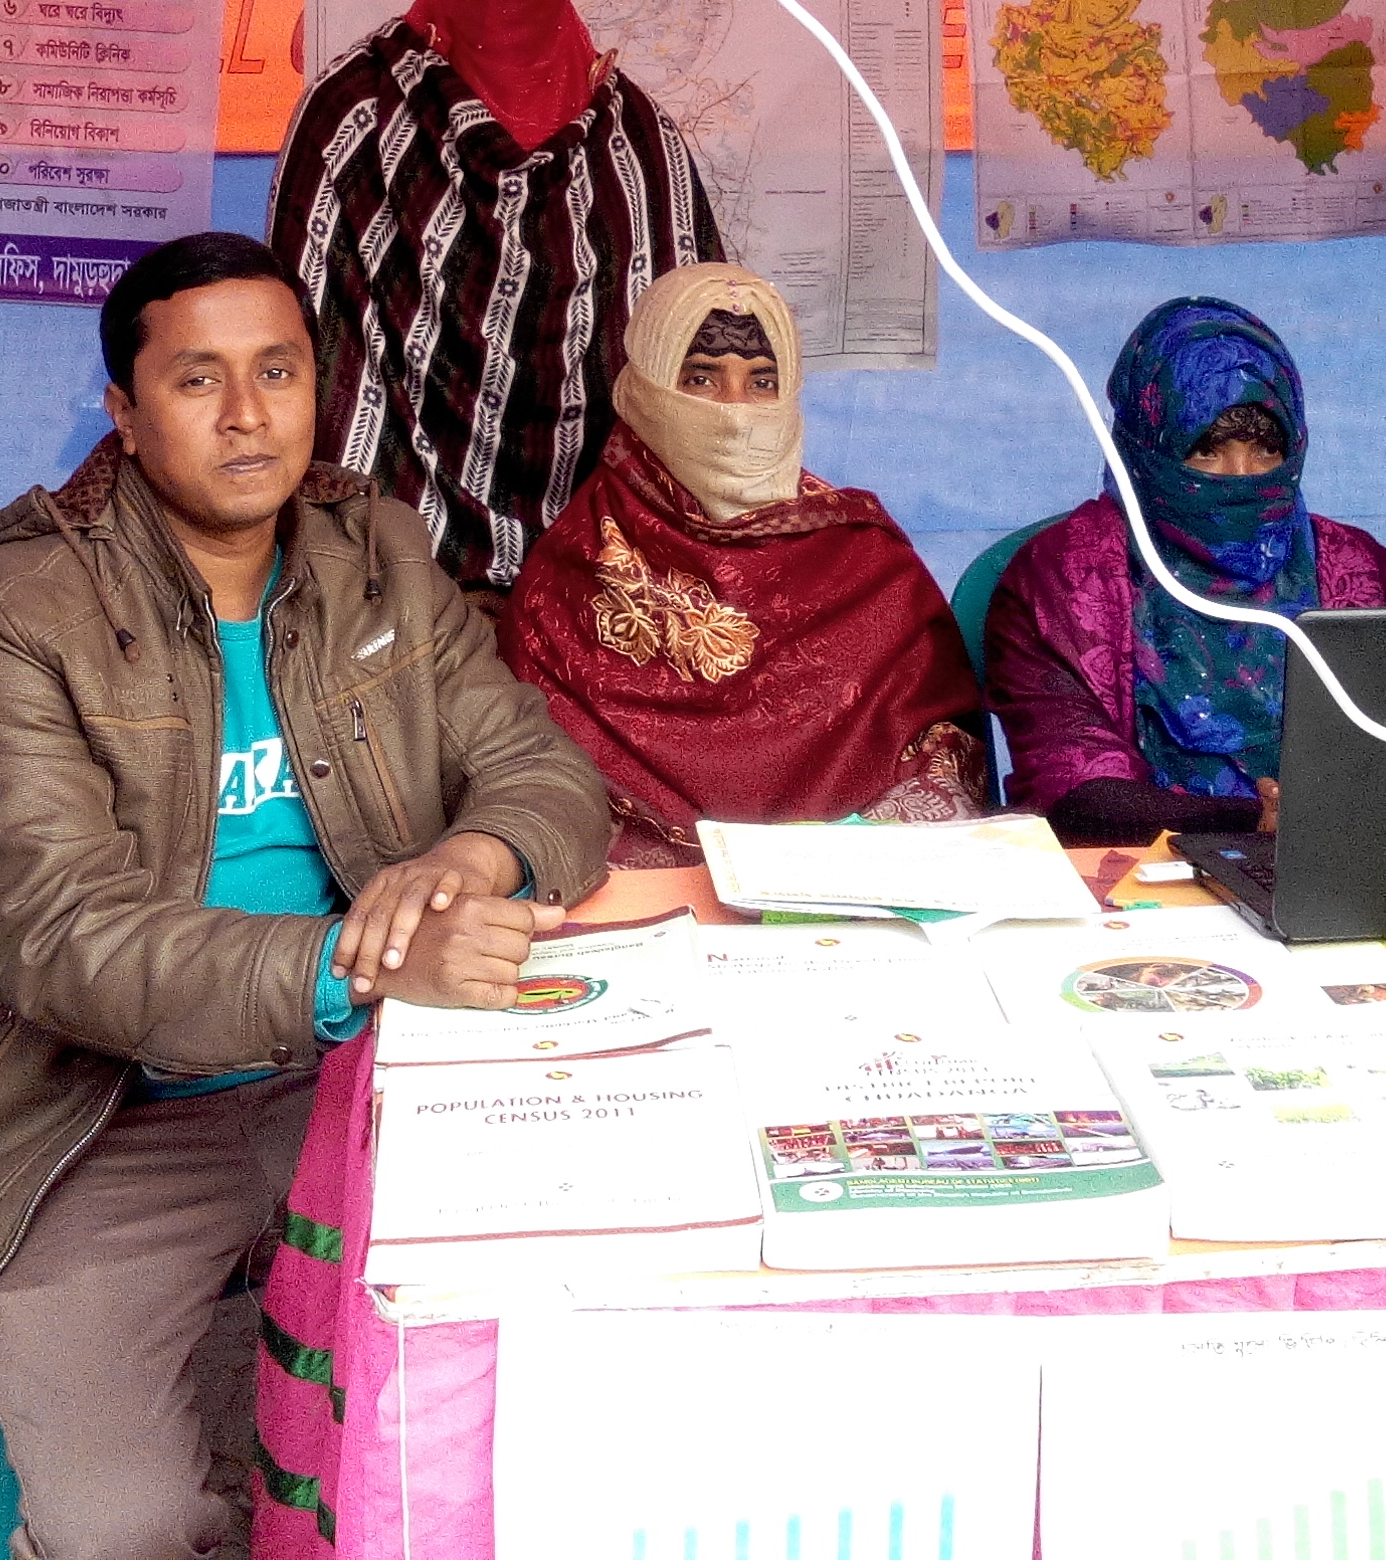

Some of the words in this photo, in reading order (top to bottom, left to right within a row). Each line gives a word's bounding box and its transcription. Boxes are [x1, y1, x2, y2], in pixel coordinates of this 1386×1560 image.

[39, 3, 60, 18] ঘরে
[67, 5, 88, 20] ঘরে
[35, 39, 91, 60] কমিউনিটি
[33, 81, 85, 101] সামাজিক
[138, 85, 177, 109] কর্মসূচি
[30, 119, 81, 140] বিনিয়োগ
[84, 121, 119, 142] বিকাশ
[28, 160, 71, 181] পরিবেশ
[76, 168, 110, 185] সুরক্ষা
[54, 200, 116, 219] বাংলাদেশ
[121, 205, 168, 221] সরকার
[416, 1094, 562, 1115] POPULATION
[572, 1094, 584, 1104] &
[596, 1089, 704, 1103] HOUSING
[484, 1108, 571, 1125] CENSUS
[582, 1106, 636, 1120] 2011
